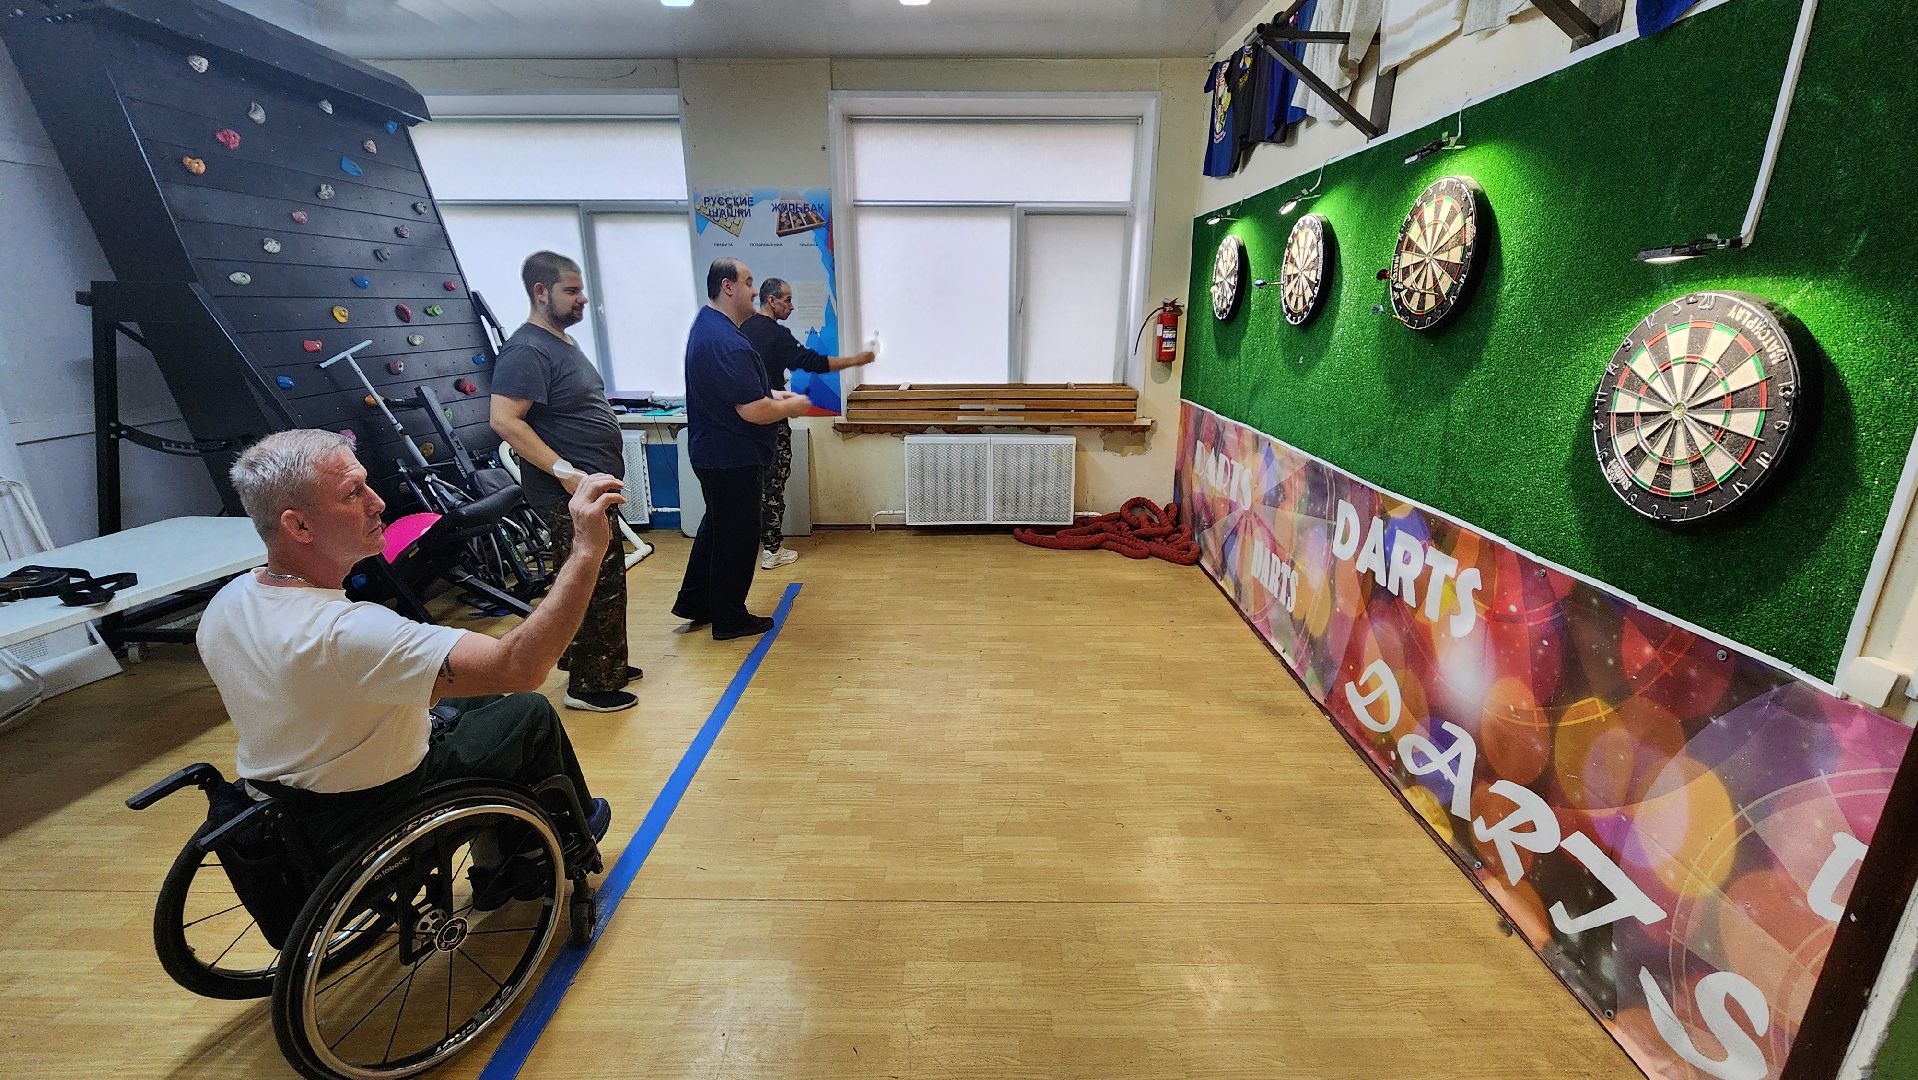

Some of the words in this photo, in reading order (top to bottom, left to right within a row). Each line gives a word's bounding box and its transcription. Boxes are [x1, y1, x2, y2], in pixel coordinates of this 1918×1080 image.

[703, 196, 754, 207] РУССКИЕ
[708, 208, 752, 218] ШАШКИ
[1195, 440, 1252, 510] DARTS
[1250, 538, 1300, 613] DARTS
[1332, 499, 1482, 638] DARTS
[1345, 659, 1769, 1080] DARTS
